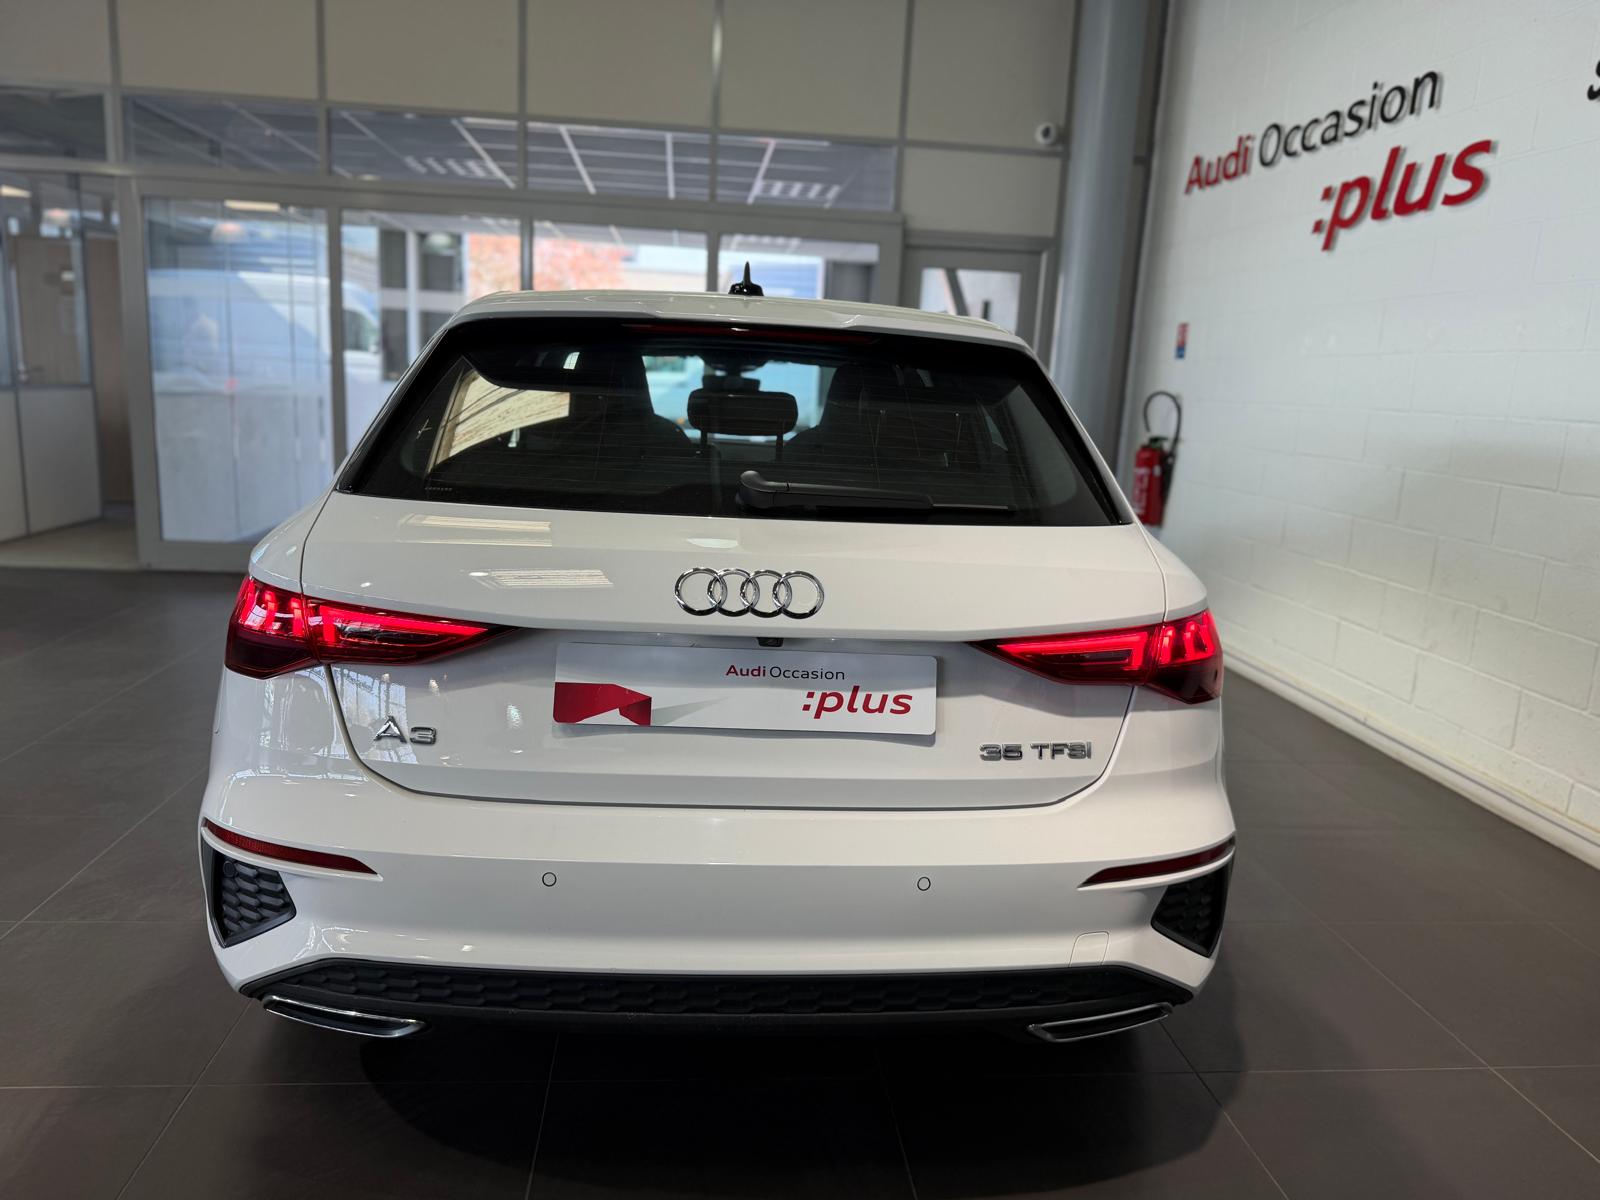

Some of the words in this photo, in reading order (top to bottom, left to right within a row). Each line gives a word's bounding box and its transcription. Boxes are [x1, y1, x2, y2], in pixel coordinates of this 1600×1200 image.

[1185, 135, 1254, 195] Audi
[1258, 70, 1440, 168] Occasion
[725, 664, 767, 678] Audi
[769, 666, 846, 681] Occasion
[373, 715, 437, 745] A3
[979, 743, 1023, 761] 35
[1030, 741, 1092, 760] TFSI
